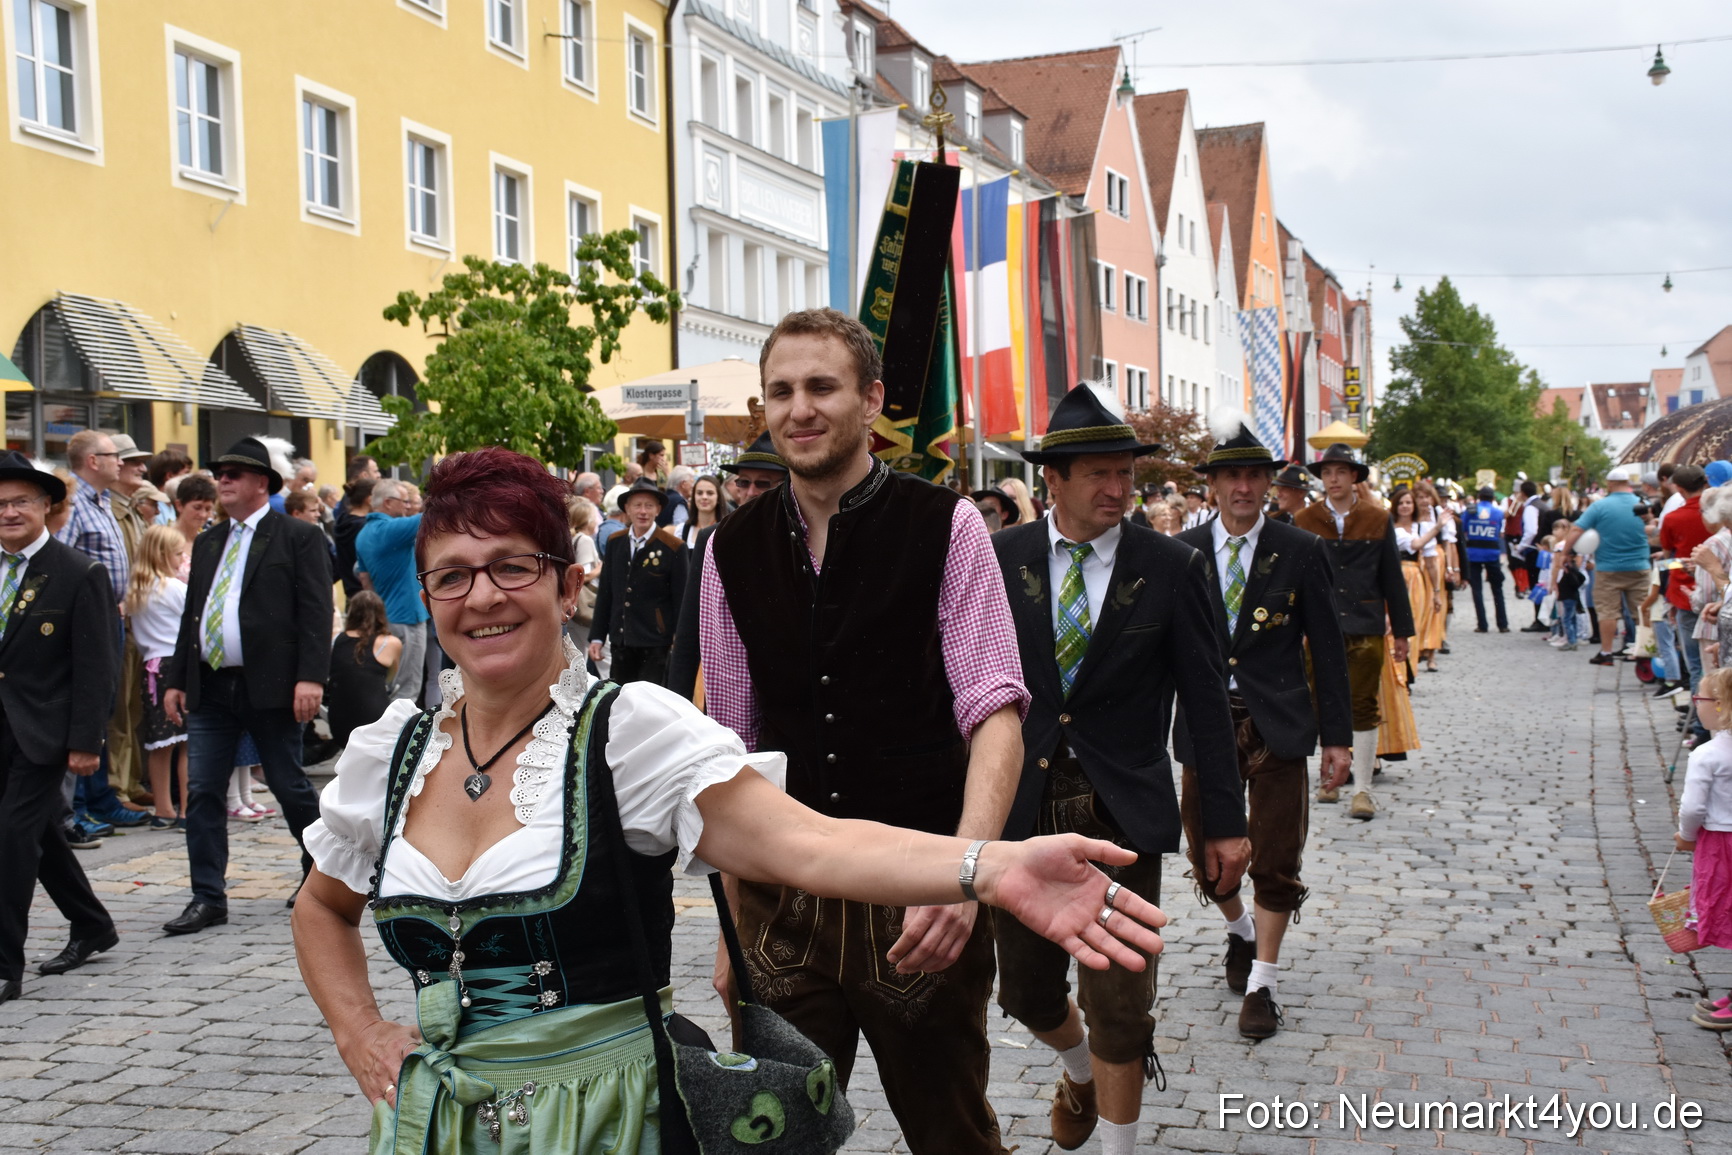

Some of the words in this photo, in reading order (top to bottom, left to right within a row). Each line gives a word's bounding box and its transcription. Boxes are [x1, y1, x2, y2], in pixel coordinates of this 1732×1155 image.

[626, 388, 682, 400] Klostergasse
[1345, 368, 1360, 429] HOTE
[1469, 525, 1496, 537] LIVE
